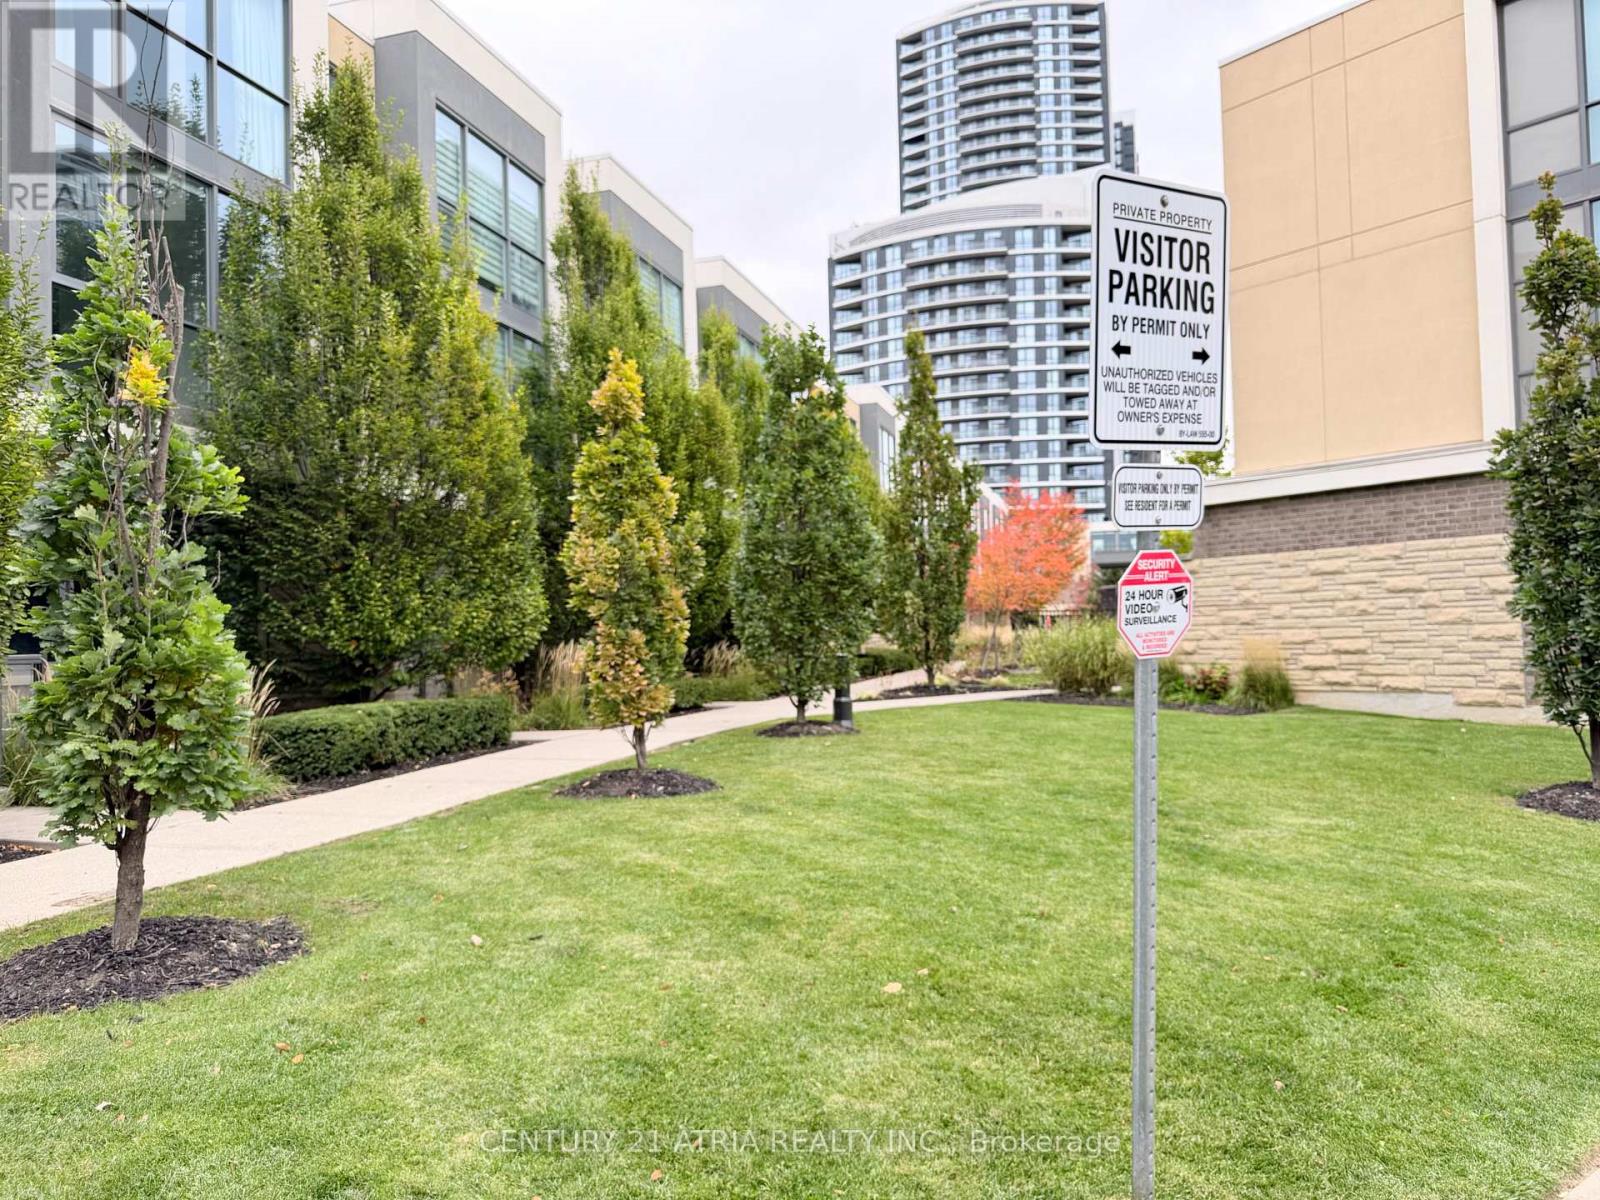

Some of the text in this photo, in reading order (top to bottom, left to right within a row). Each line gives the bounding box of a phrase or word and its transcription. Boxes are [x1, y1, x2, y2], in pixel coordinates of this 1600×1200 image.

[1113, 202, 1212, 230] PRIVATE PROPERTY
[1114, 227, 1210, 274] VISITOR
[1108, 269, 1215, 314] PARKING
[1112, 314, 1210, 339] BY PERMIT ONLY
[1101, 366, 1218, 384] UNAUTHORIZED VEHICLES
[1103, 381, 1216, 398] WILL BE TAGGED AND/OR
[1123, 396, 1198, 410] TOWED AWAY AT
[1117, 411, 1202, 425] OWNER'S EXPENSE
[1118, 482, 1199, 495] VISITOR PARKING ONLY BY PERMIT
[1125, 500, 1192, 511] SEE RESIDENT FOR A PERMIT
[1137, 558, 1176, 570] SECURITY
[1143, 570, 1169, 581] ALERT
[1125, 589, 1163, 601] 24 HOUR
[1125, 603, 1153, 614] VIDEO
[1124, 614, 1177, 626] SURVEILLANCE
